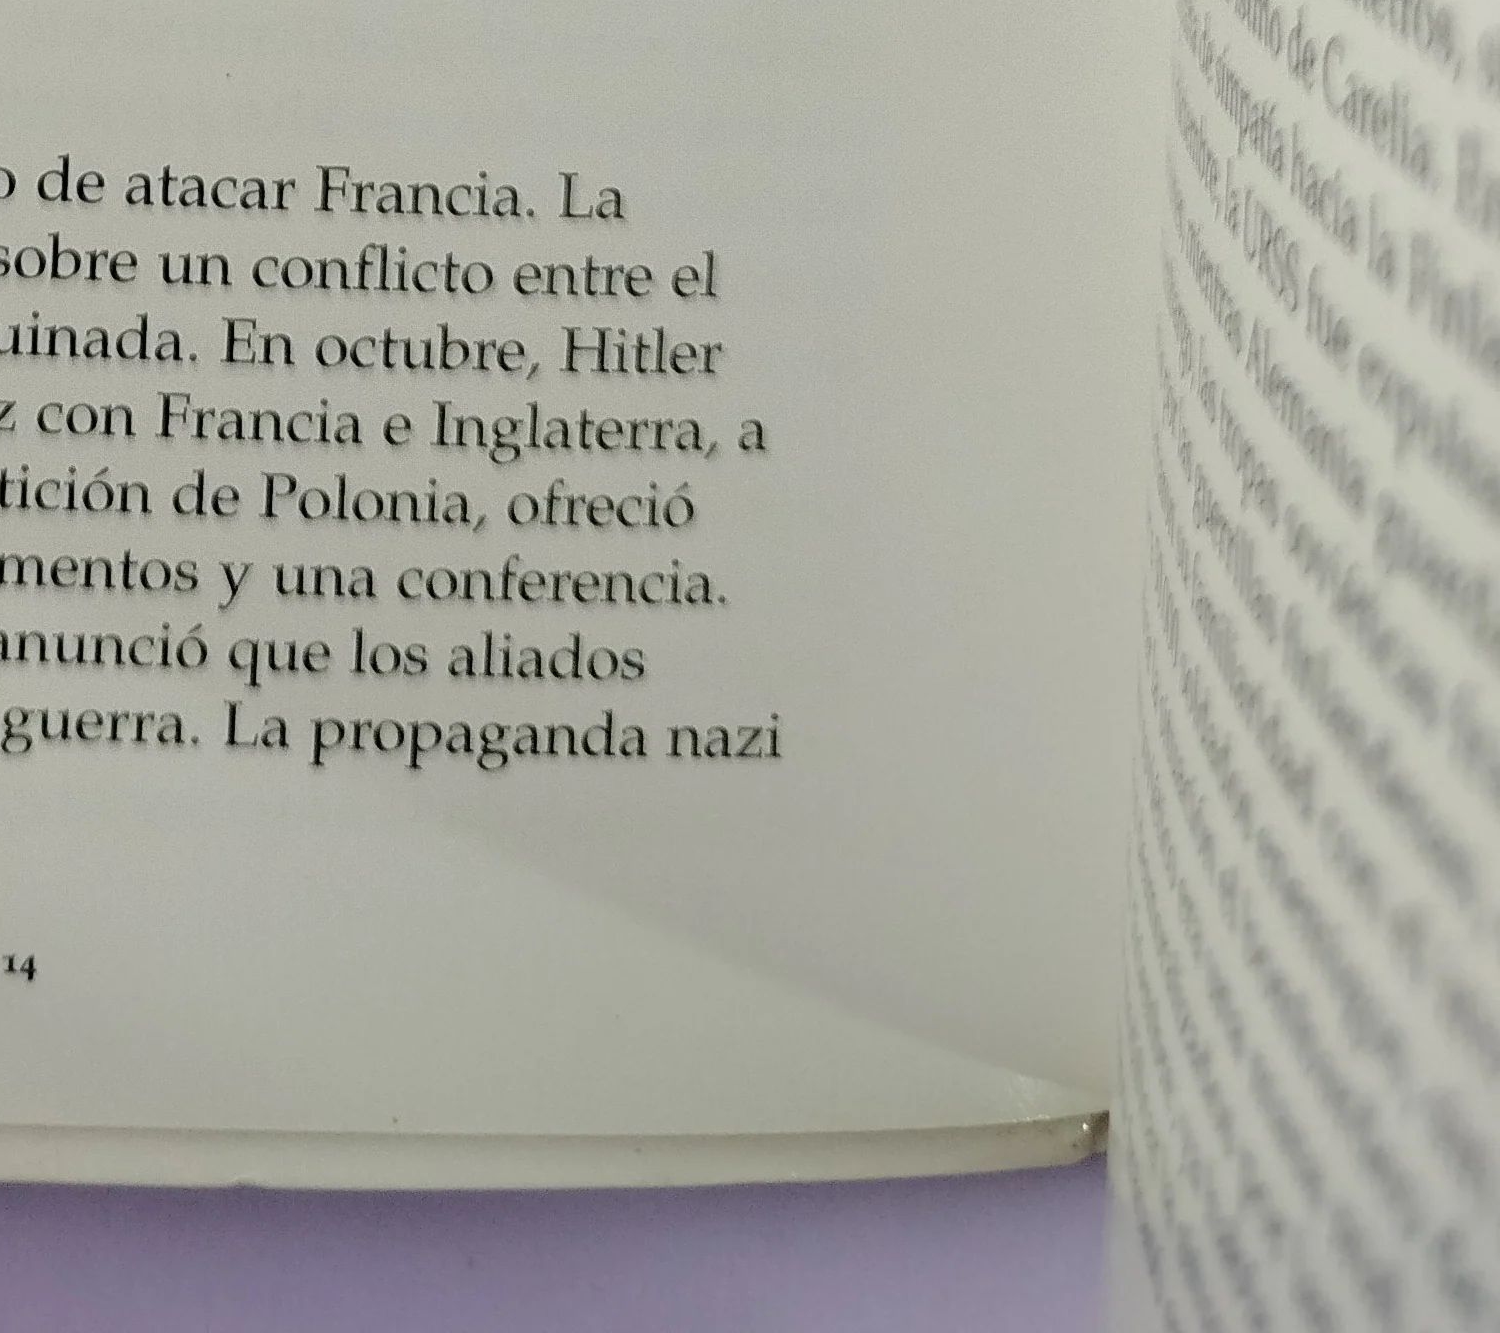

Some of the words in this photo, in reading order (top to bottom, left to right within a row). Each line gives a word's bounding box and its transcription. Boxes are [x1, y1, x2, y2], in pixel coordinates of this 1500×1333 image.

[37, 154, 105, 204] de
[125, 165, 296, 213] atacar
[314, 165, 535, 221] Francia.
[559, 172, 625, 222] La
[158, 252, 232, 291] un
[252, 243, 493, 297] conflicto
[513, 255, 655, 300] entre
[671, 250, 719, 301] el
[220, 317, 295, 369] En
[315, 323, 539, 380] octubre,
[560, 326, 724, 378] Hitler
[37, 402, 136, 440] con
[155, 392, 362, 448] Francia
[383, 414, 413, 448] e
[430, 401, 718, 467] Inglaterra,
[738, 419, 767, 454] a
[173, 468, 240, 521] de
[259, 472, 486, 533] Polonia,
[508, 478, 697, 531] ofreció
[218, 562, 253, 613] y
[272, 563, 377, 602] una
[397, 553, 726, 608] conferencia.
[229, 638, 331, 690] que
[351, 627, 428, 677] los
[448, 630, 645, 683] aliados
[1, 707, 199, 756] guerra.
[225, 701, 289, 751] La
[309, 709, 647, 772] propaganda
[666, 713, 782, 760] nazi
[2, 953, 38, 981] 14
